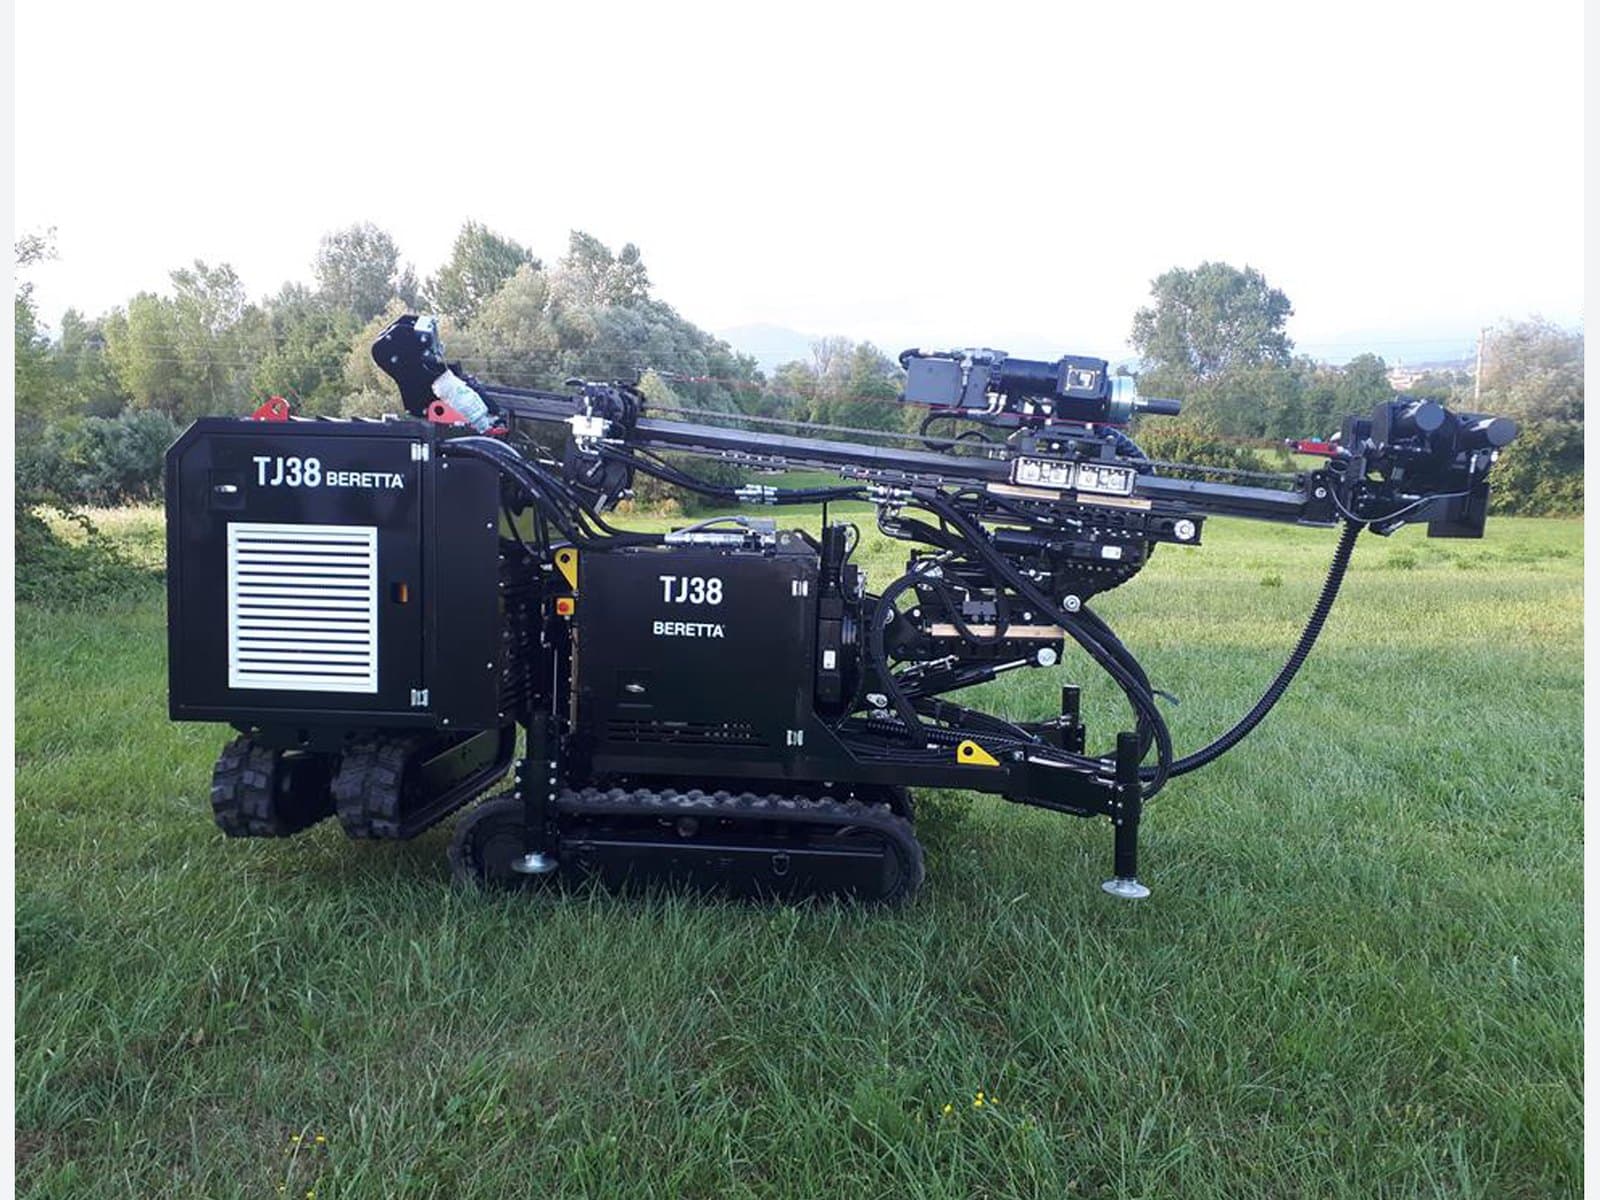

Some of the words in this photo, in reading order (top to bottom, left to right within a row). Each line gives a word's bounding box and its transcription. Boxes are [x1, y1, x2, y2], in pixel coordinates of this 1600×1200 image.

[253, 456, 322, 488] TJ38
[326, 471, 404, 489] BERETTA
[660, 576, 723, 605] TJ38
[653, 621, 724, 638] BERETTA
